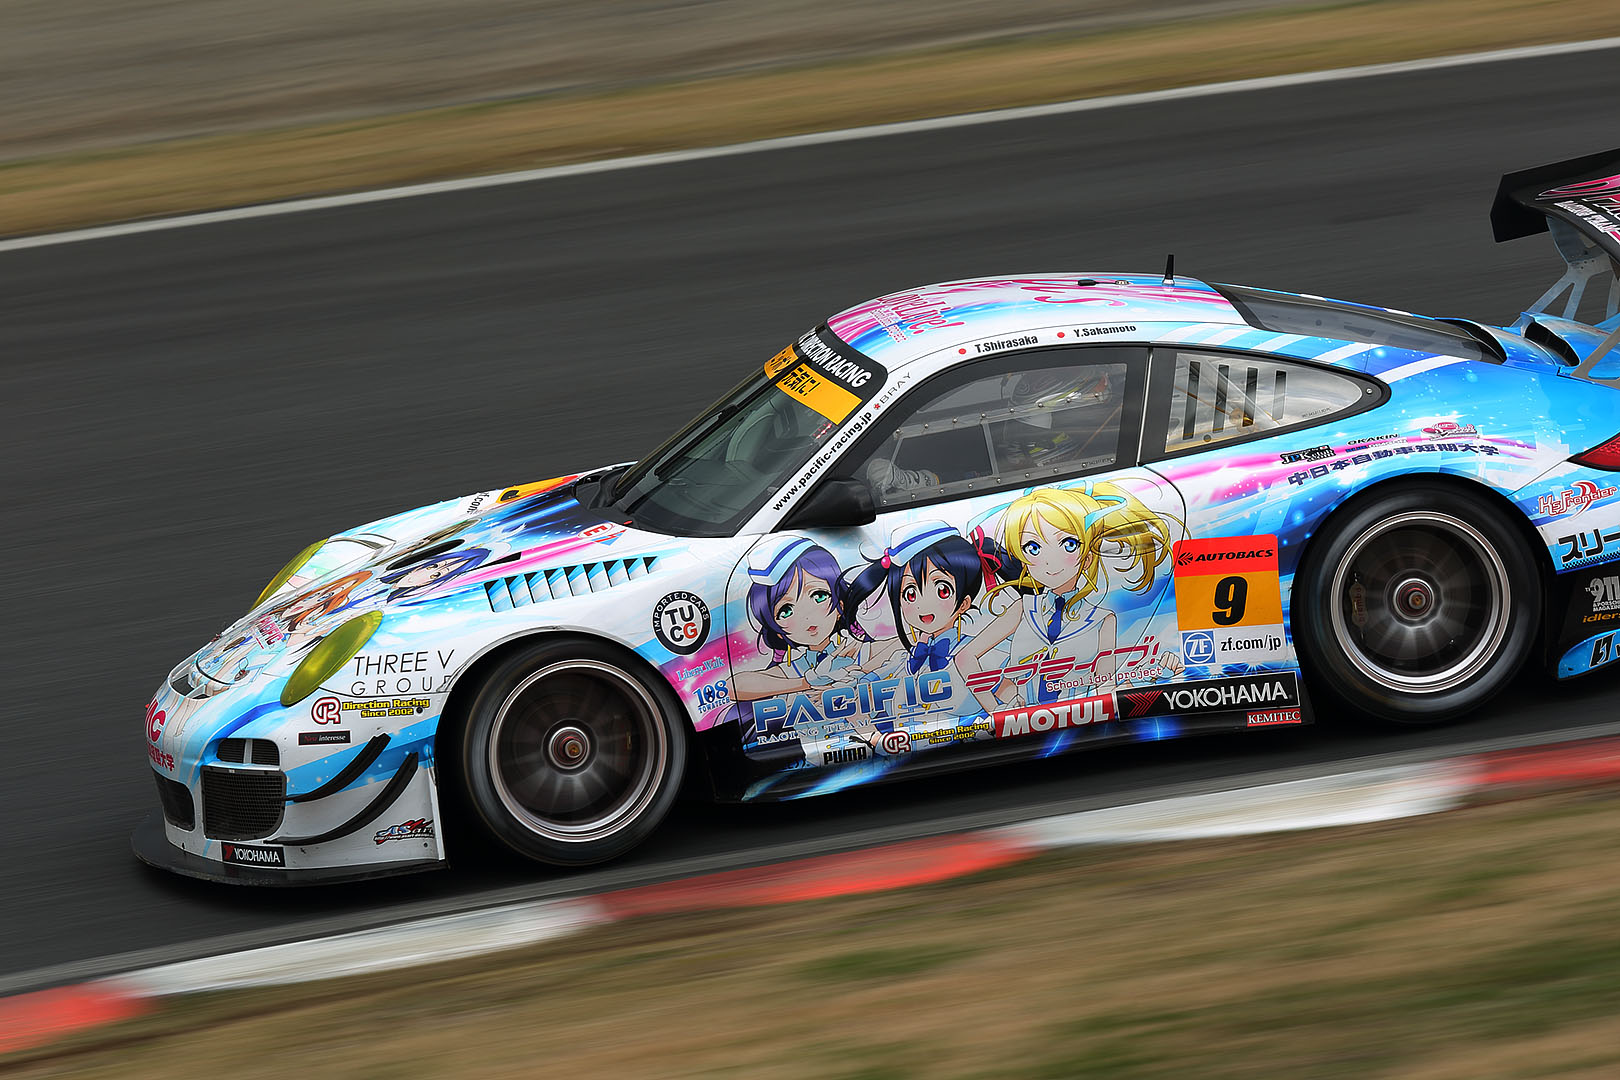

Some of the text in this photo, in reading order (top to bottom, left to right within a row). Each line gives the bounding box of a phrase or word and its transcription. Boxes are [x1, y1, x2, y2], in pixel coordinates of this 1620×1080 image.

[1073, 325, 1137, 338] Y.Sakamoto
[974, 335, 1039, 353] T.Shirasaka
[826, 355, 872, 388] RACING
[879, 372, 911, 404] BRAY
[1347, 434, 1400, 446] OKAKIN
[772, 411, 872, 512] www.pacific-racing.jp
[1287, 443, 1500, 486] 中日本自動車短期大学
[1195, 549, 1274, 562] AUTOBACS
[1590, 575, 1620, 602] 911
[654, 592, 710, 632] IMPORTED CARS
[1212, 576, 1248, 626] 9
[665, 605, 695, 625] TU
[669, 622, 698, 643] CG
[1186, 634, 1282, 658] ZF zf.com/jp
[354, 649, 455, 677] THREE V
[676, 657, 726, 681] Liberty Walk
[965, 636, 1161, 693] ラブライブ!
[1046, 666, 1163, 693] School idol project
[342, 700, 391, 712] Direction
[391, 698, 430, 709] Racing
[692, 680, 729, 708] 108
[698, 697, 731, 714] TOWATECH
[752, 670, 953, 734] PACIFIC
[1162, 681, 1289, 710] YOKOHAMA
[360, 708, 415, 718] Since 2002
[1001, 700, 1110, 738] MOTUL
[1247, 710, 1301, 725] KEMITEC
[756, 718, 871, 746] RACING TEAM
[911, 728, 956, 741] Direction
[956, 722, 990, 734] Racing
[929, 731, 976, 745] Since 2002
[823, 746, 868, 765] PUMA
[233, 846, 281, 864] YOKOHAMA
